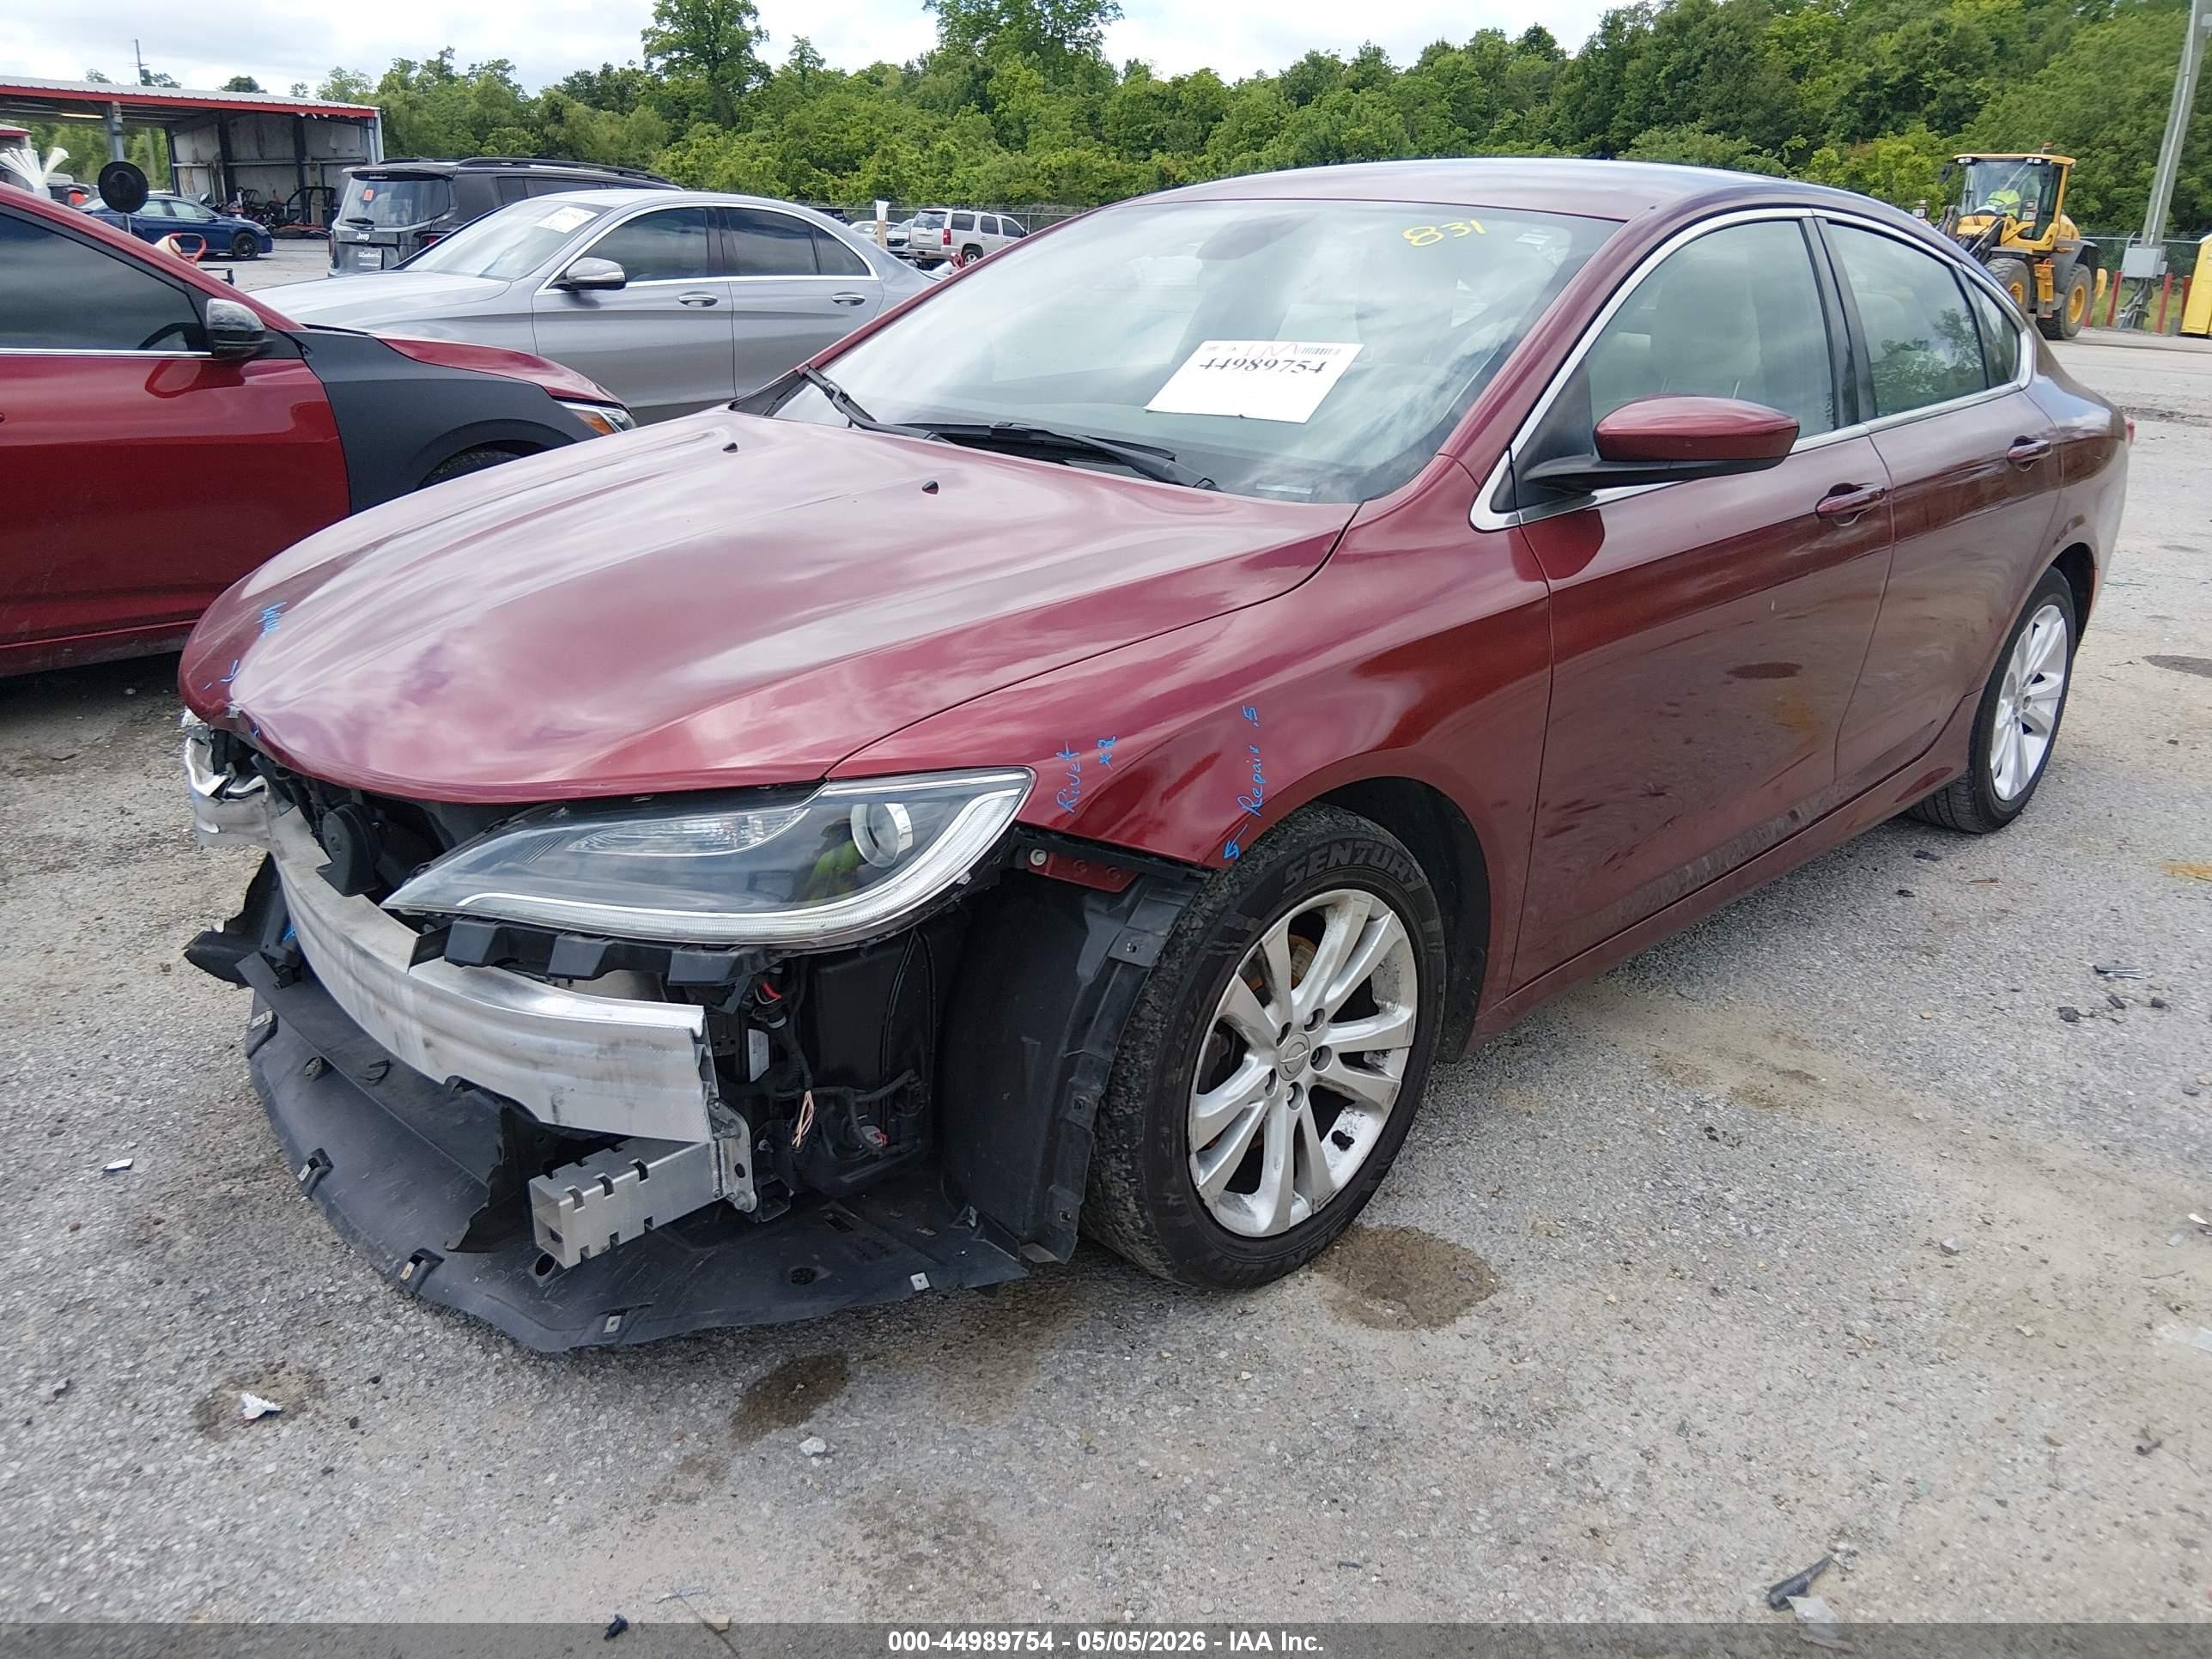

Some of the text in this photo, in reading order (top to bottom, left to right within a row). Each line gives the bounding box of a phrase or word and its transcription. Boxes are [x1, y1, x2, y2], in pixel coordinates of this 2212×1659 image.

[356, 232, 370, 241] Jeep
[1402, 220, 1486, 246] 831
[1199, 357, 1326, 374] 44989754
